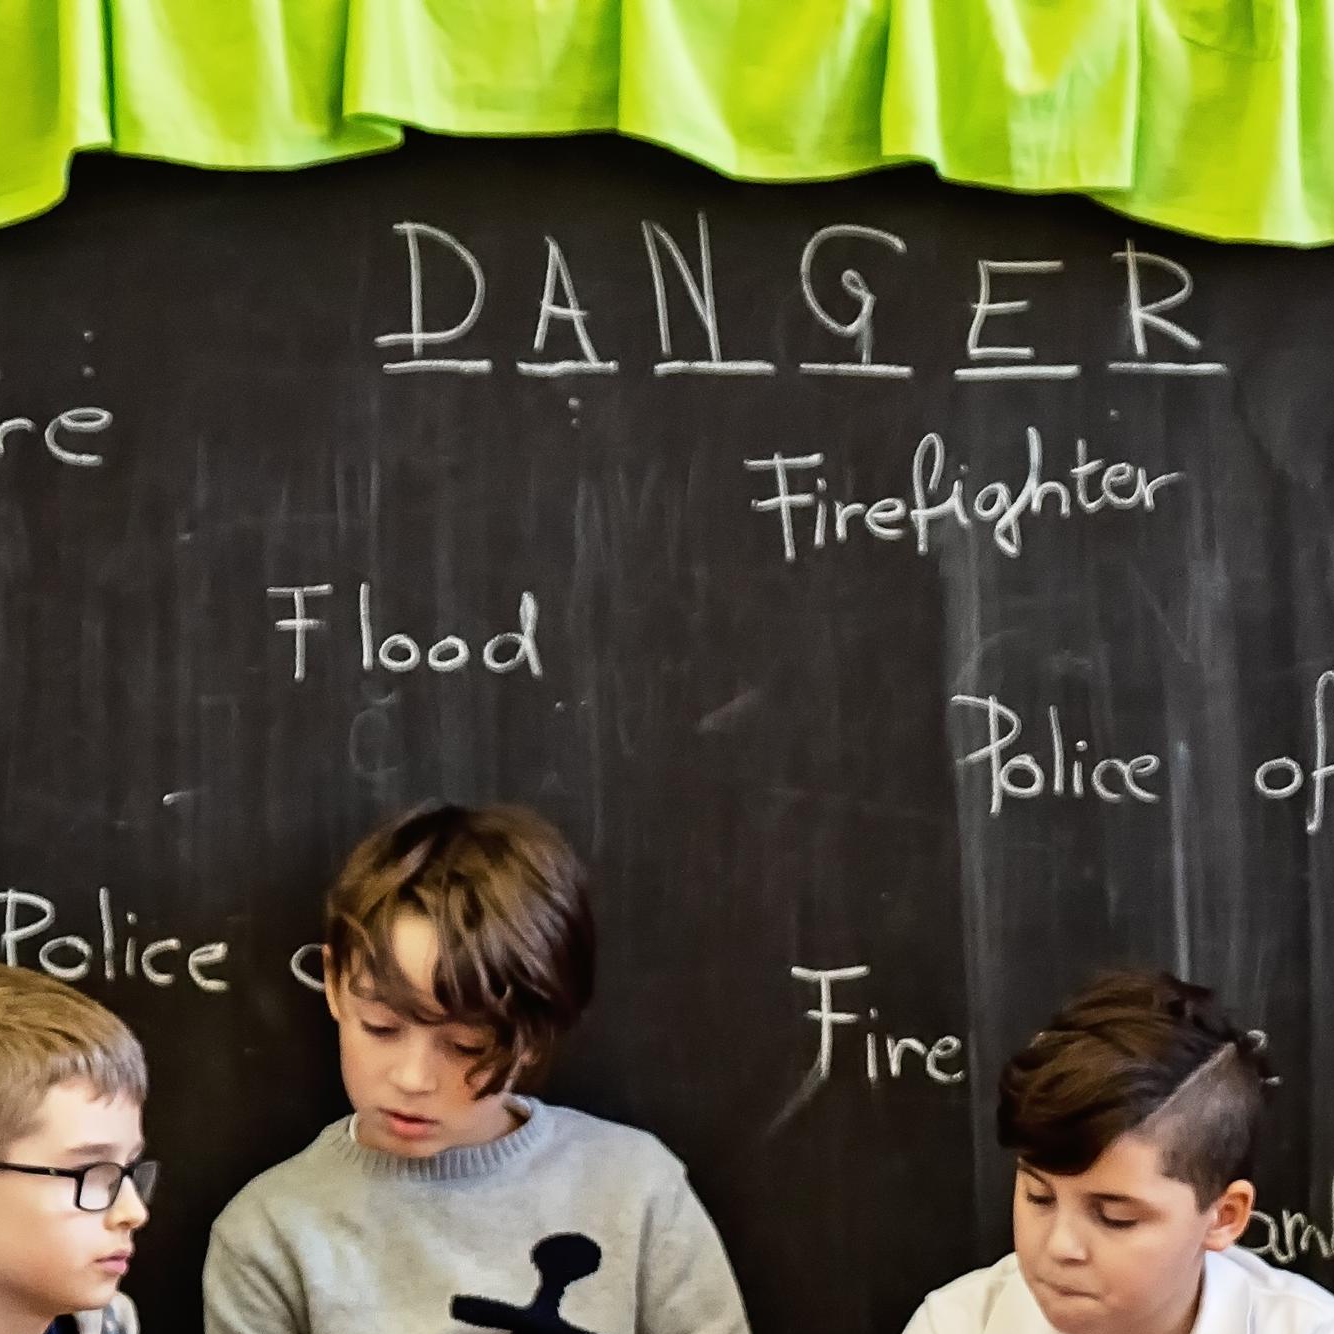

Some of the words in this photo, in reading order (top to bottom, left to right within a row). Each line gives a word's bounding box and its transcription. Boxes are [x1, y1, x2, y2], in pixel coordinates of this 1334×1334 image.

[375, 211, 1222, 374] DANGER
[743, 426, 1183, 562] Firefighter
[266, 582, 543, 681] Flood
[950, 693, 1161, 817] Police
[790, 965, 965, 1084] Fire
